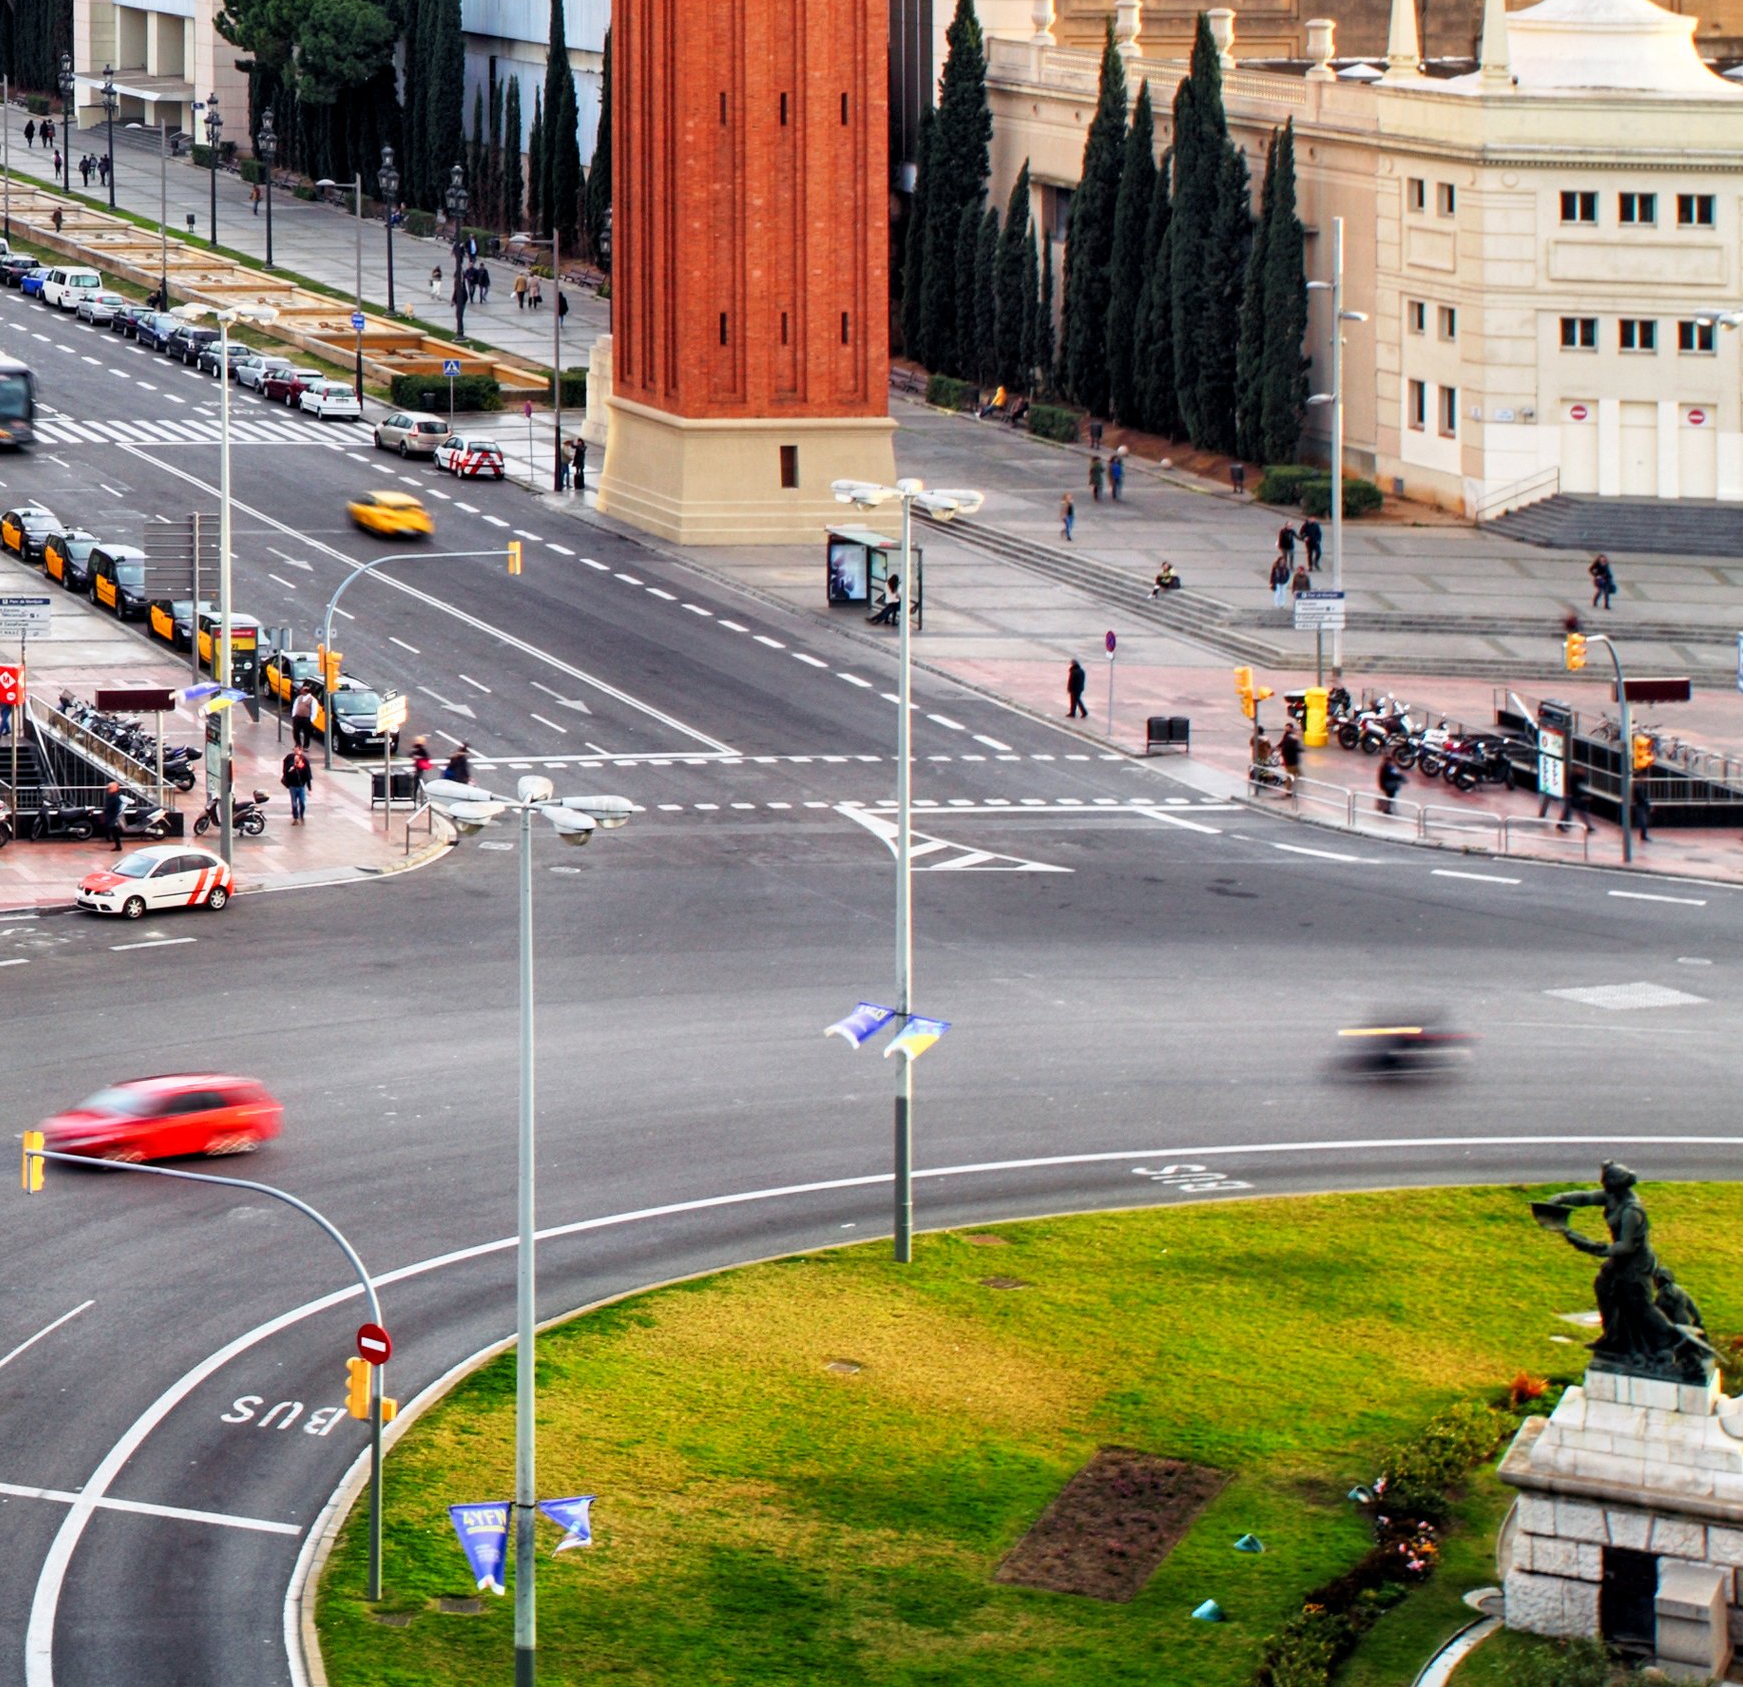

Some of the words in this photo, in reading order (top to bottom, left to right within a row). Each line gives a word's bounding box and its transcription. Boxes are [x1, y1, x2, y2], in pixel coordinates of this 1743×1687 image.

[1130, 1163, 1255, 1193] BUS
[219, 1394, 349, 1437] BUS
[462, 1508, 507, 1527] 4YFN
